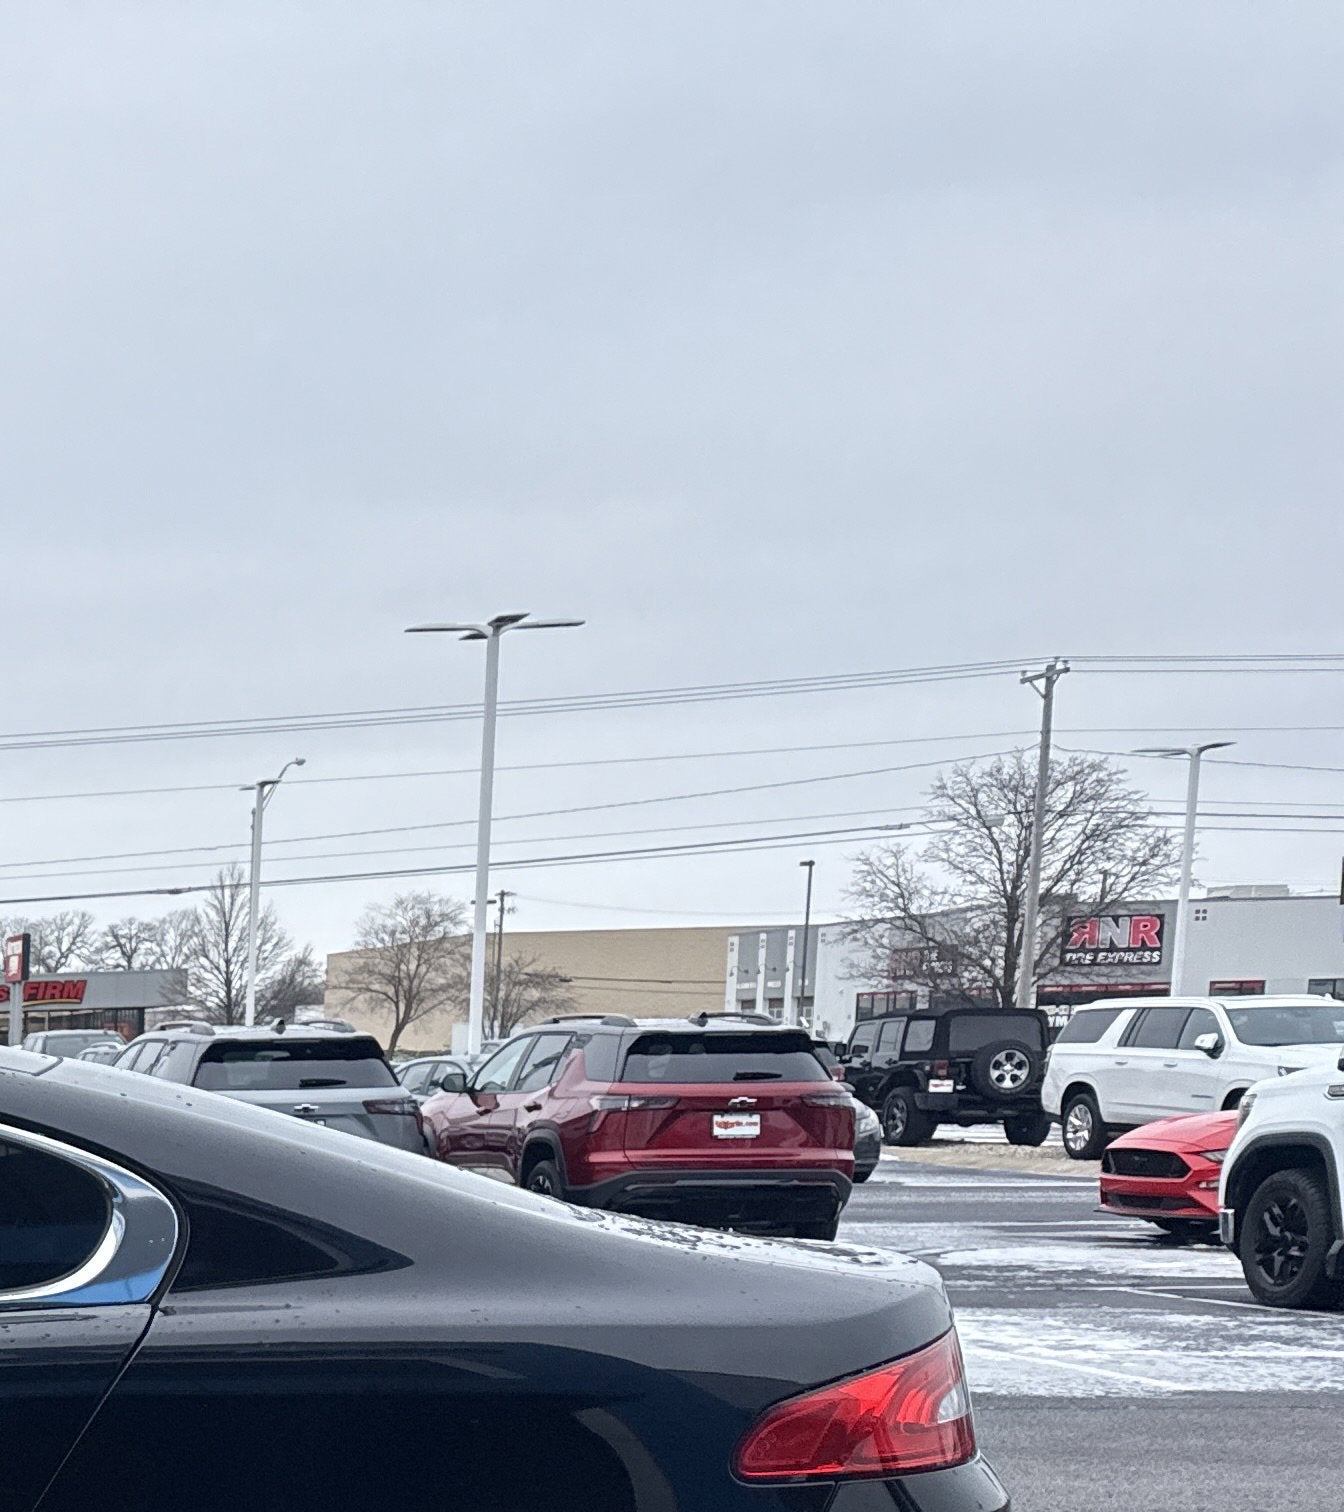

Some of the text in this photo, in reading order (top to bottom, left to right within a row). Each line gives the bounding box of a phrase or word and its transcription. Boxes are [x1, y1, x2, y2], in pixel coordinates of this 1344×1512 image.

[1065, 916, 1161, 949] RNR
[1096, 951, 1161, 963] EXPRESS
[22, 979, 88, 1001] FIRM
